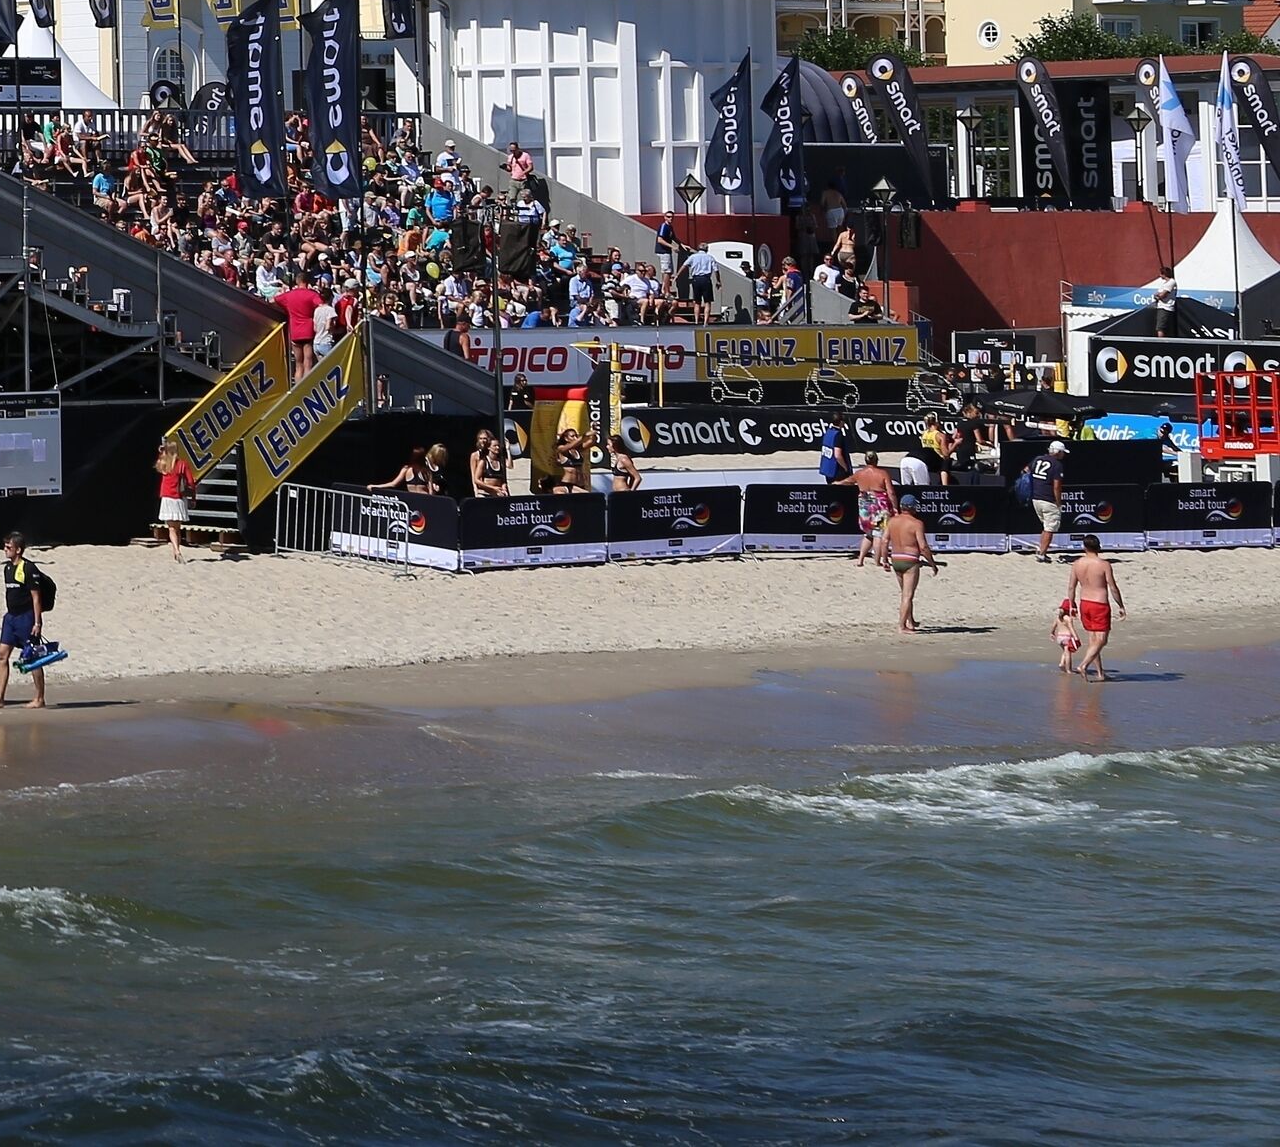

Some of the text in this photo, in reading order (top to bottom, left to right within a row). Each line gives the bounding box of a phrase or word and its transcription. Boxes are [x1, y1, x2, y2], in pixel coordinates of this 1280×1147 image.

[886, 81, 921, 135] smart
[1031, 84, 1061, 137] smart
[1243, 83, 1278, 137] smart
[592, 336, 685, 372] tpico
[706, 331, 797, 377] LEIBNIZ
[818, 331, 907, 376] LEIBNIZ
[1133, 353, 1217, 380] smart
[177, 360, 275, 471] LEIBNIZ
[254, 365, 349, 479] LEIBNIZ
[655, 417, 735, 446] smart
[1224, 441, 1255, 451] mateco
[1035, 459, 1050, 477] 12
[916, 502, 937, 513] each
[1061, 491, 1084, 500] mart
